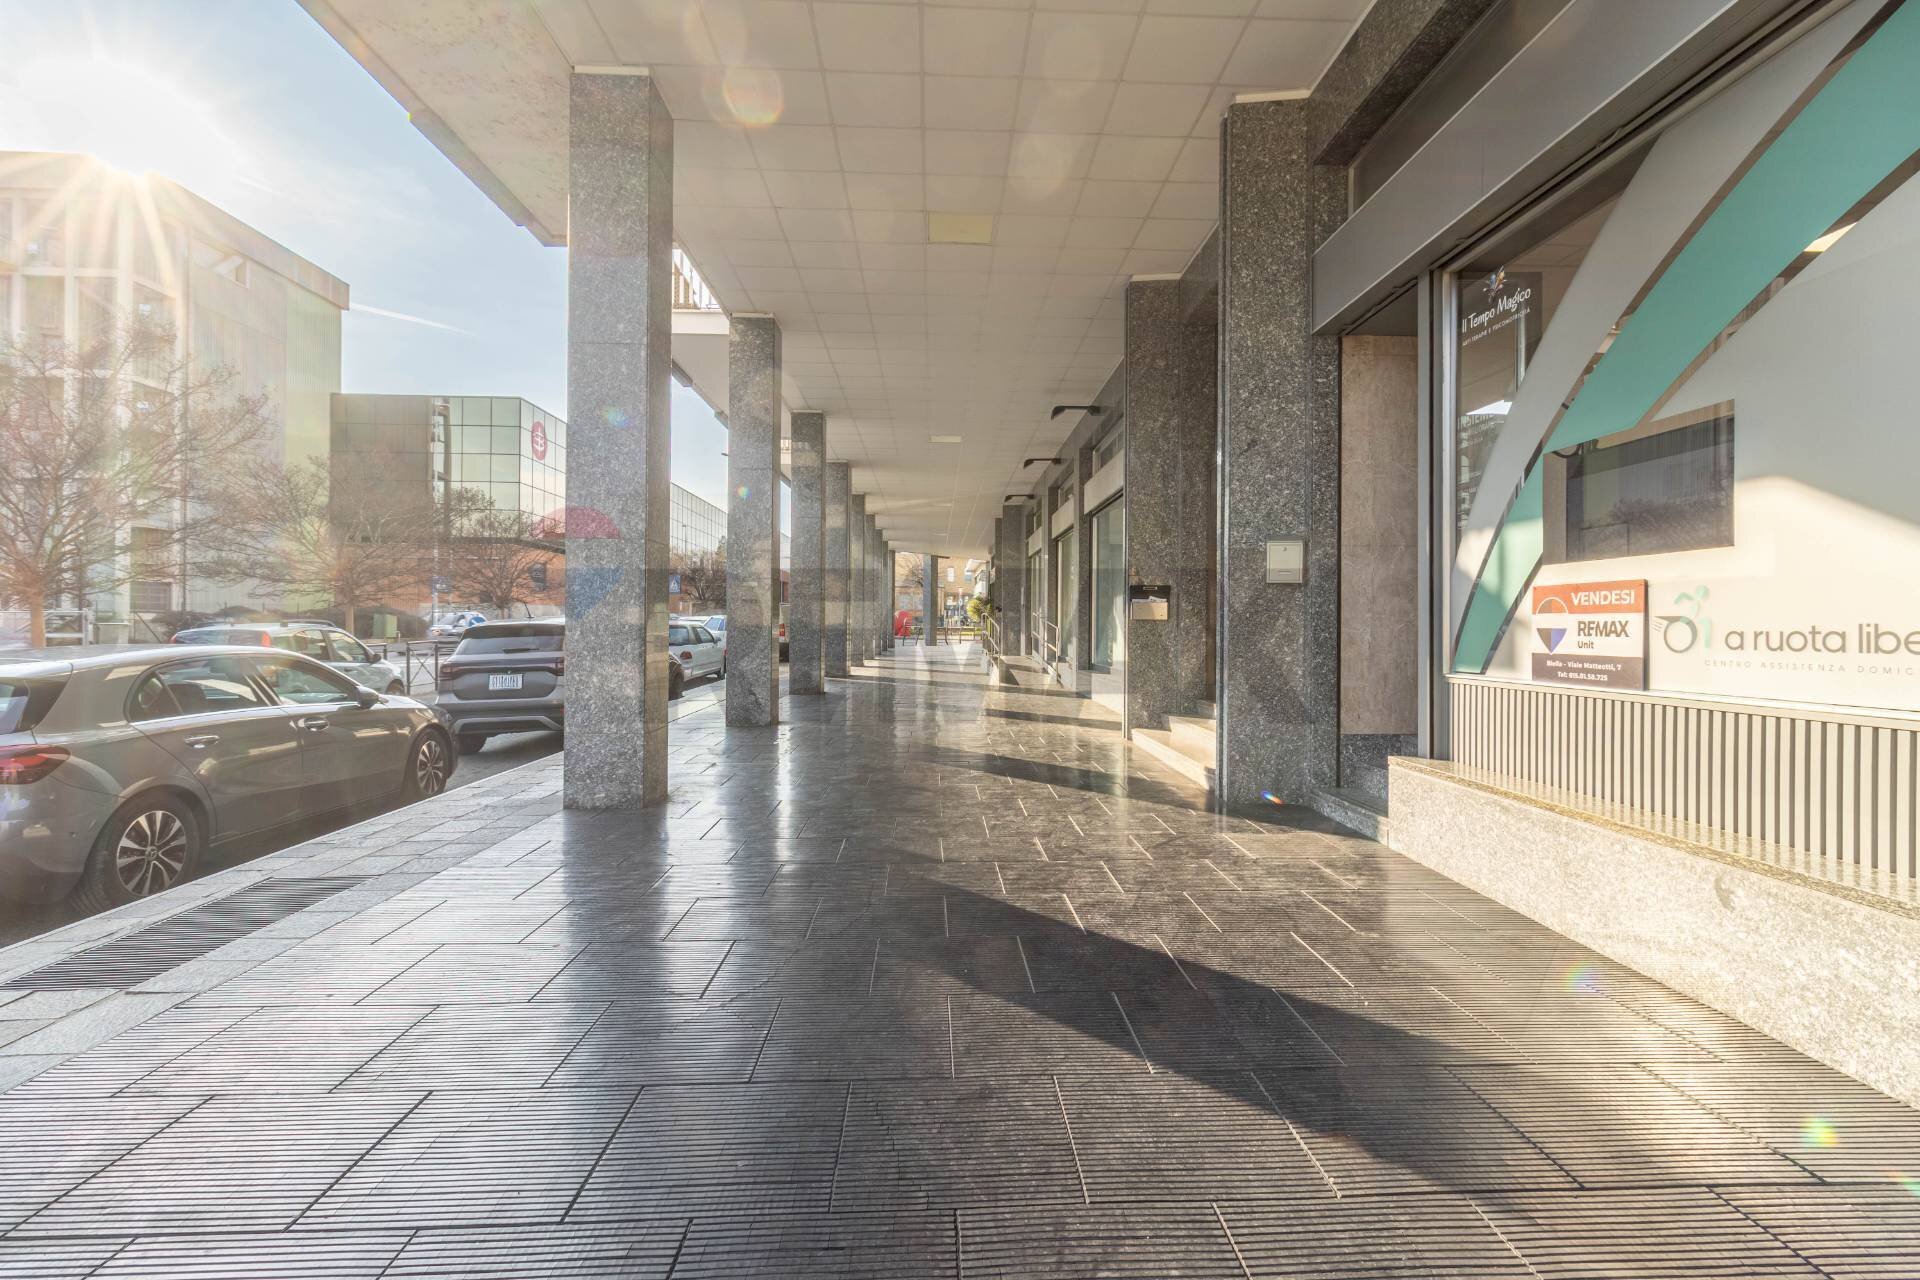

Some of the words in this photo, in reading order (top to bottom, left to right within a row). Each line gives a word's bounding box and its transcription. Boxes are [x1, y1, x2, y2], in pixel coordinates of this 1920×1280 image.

[1462, 319, 1467, 333] Il
[1468, 308, 1495, 329] Tempo
[1497, 288, 1531, 314] Magico
[1571, 589, 1635, 606] VENDESI
[1577, 620, 1630, 638] REMAX
[1577, 641, 1594, 649] Unit
[1725, 630, 1744, 651] a
[1753, 625, 1847, 653] ruota
[1568, 661, 1583, 669] Viale
[1704, 659, 1752, 669] CENTRO
[1760, 662, 1846, 673] ASSISTENZA
